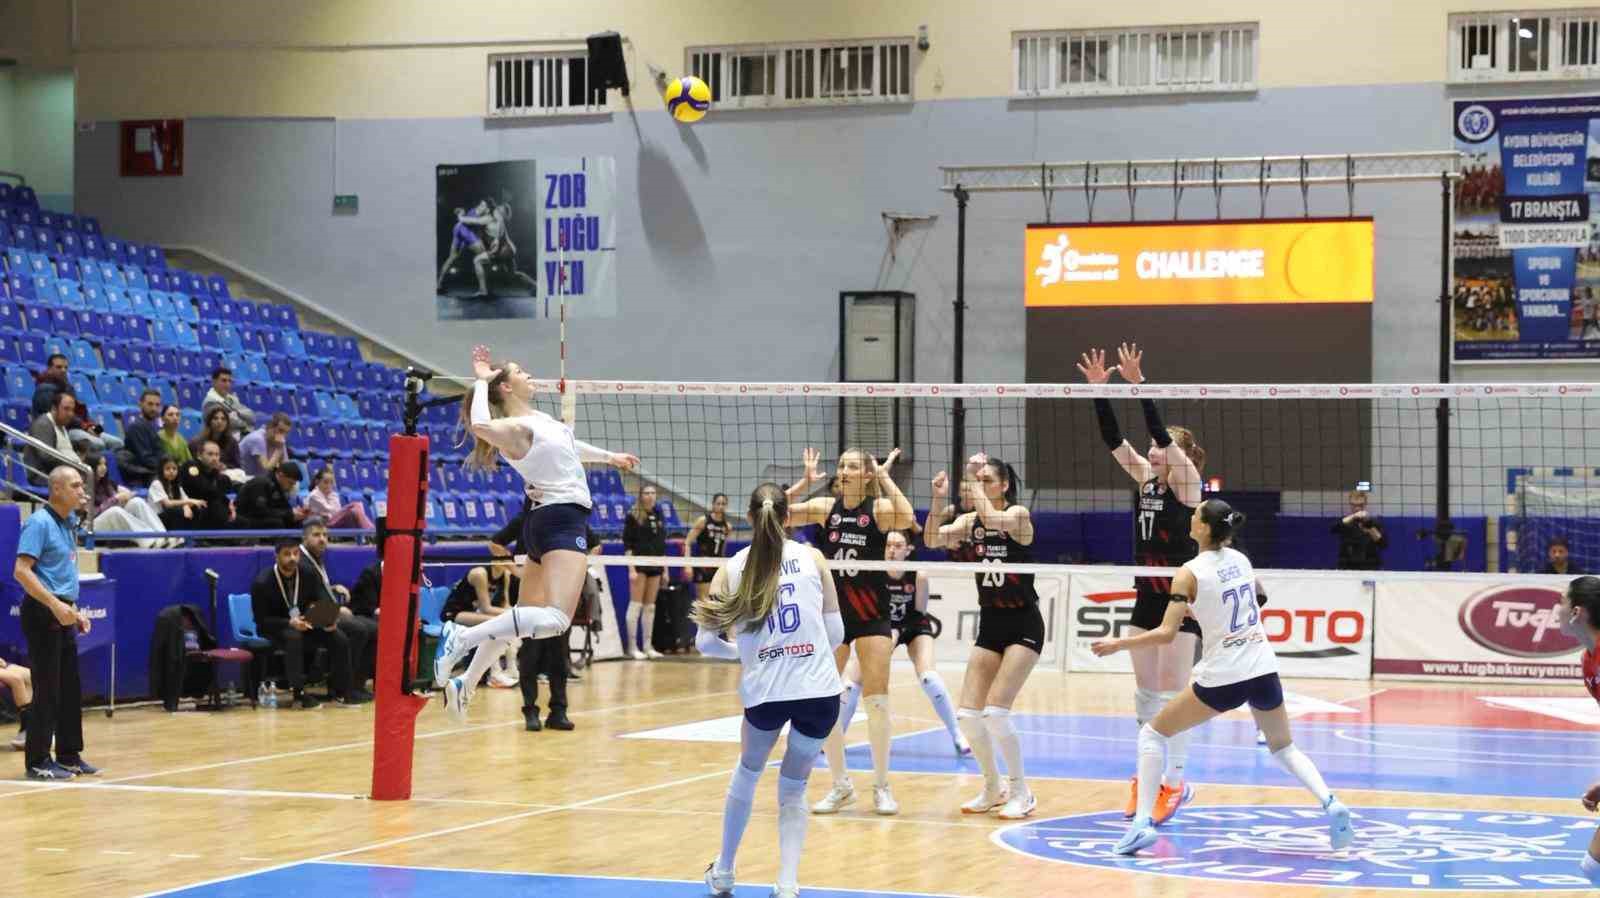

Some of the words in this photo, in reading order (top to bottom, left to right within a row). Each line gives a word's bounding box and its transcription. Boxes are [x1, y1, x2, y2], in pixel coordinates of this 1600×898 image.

[544, 173, 586, 209] ZOR
[1509, 202, 1522, 219] 17
[1524, 200, 1581, 221] BRANŞTA
[544, 260, 585, 296] YEN
[1135, 248, 1265, 280] CHALLENGE
[1138, 510, 1155, 541] 17
[982, 558, 1006, 588] 20
[1222, 583, 1259, 633] 23
